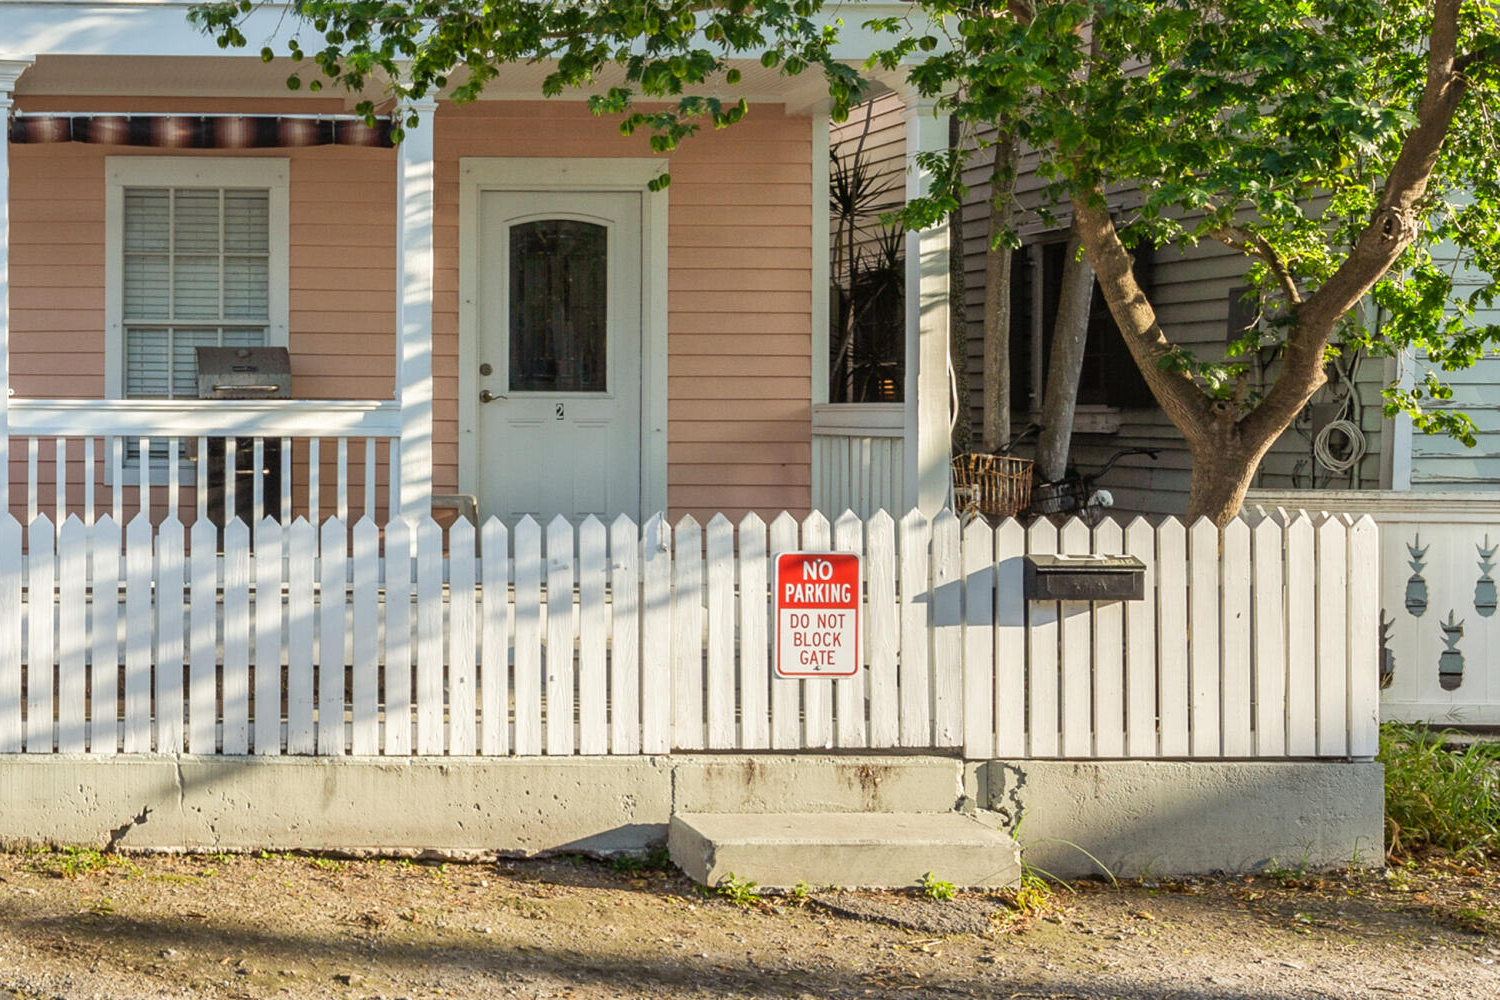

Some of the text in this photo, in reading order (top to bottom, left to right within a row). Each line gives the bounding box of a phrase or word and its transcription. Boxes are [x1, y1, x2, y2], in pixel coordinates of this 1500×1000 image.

[803, 561, 833, 580] NO
[785, 583, 851, 603] PARKING
[790, 613, 846, 629] DO NOT
[793, 632, 842, 647] BLOCK
[799, 650, 835, 665] GATE
